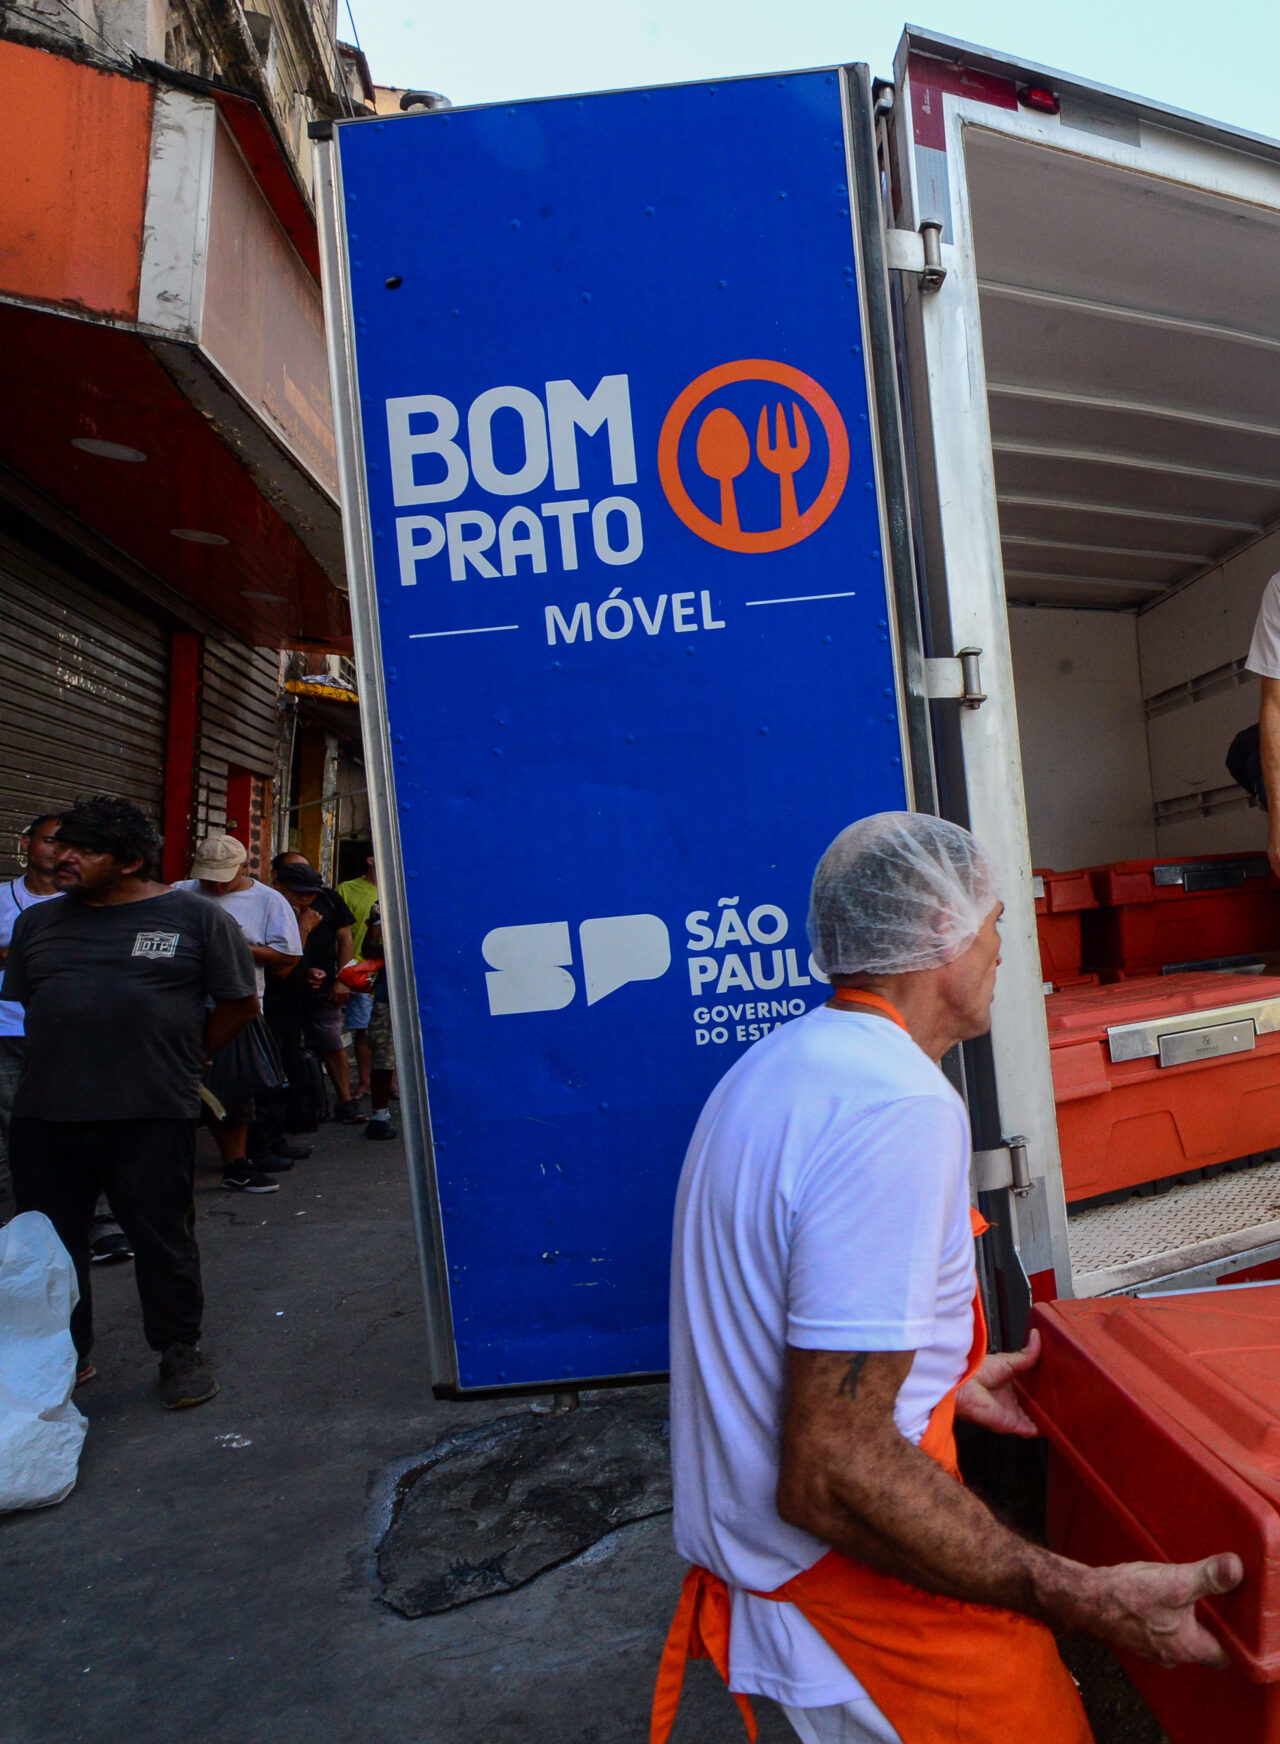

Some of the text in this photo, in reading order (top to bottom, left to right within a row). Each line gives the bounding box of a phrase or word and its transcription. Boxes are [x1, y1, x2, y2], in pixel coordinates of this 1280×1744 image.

[386, 374, 638, 507] BOM
[396, 496, 644, 586] PRATO
[545, 587, 725, 645] MÓVEL
[685, 896, 789, 951] SÃO
[693, 998, 806, 1026] GOVERNO
[695, 1028, 730, 1046] DO
